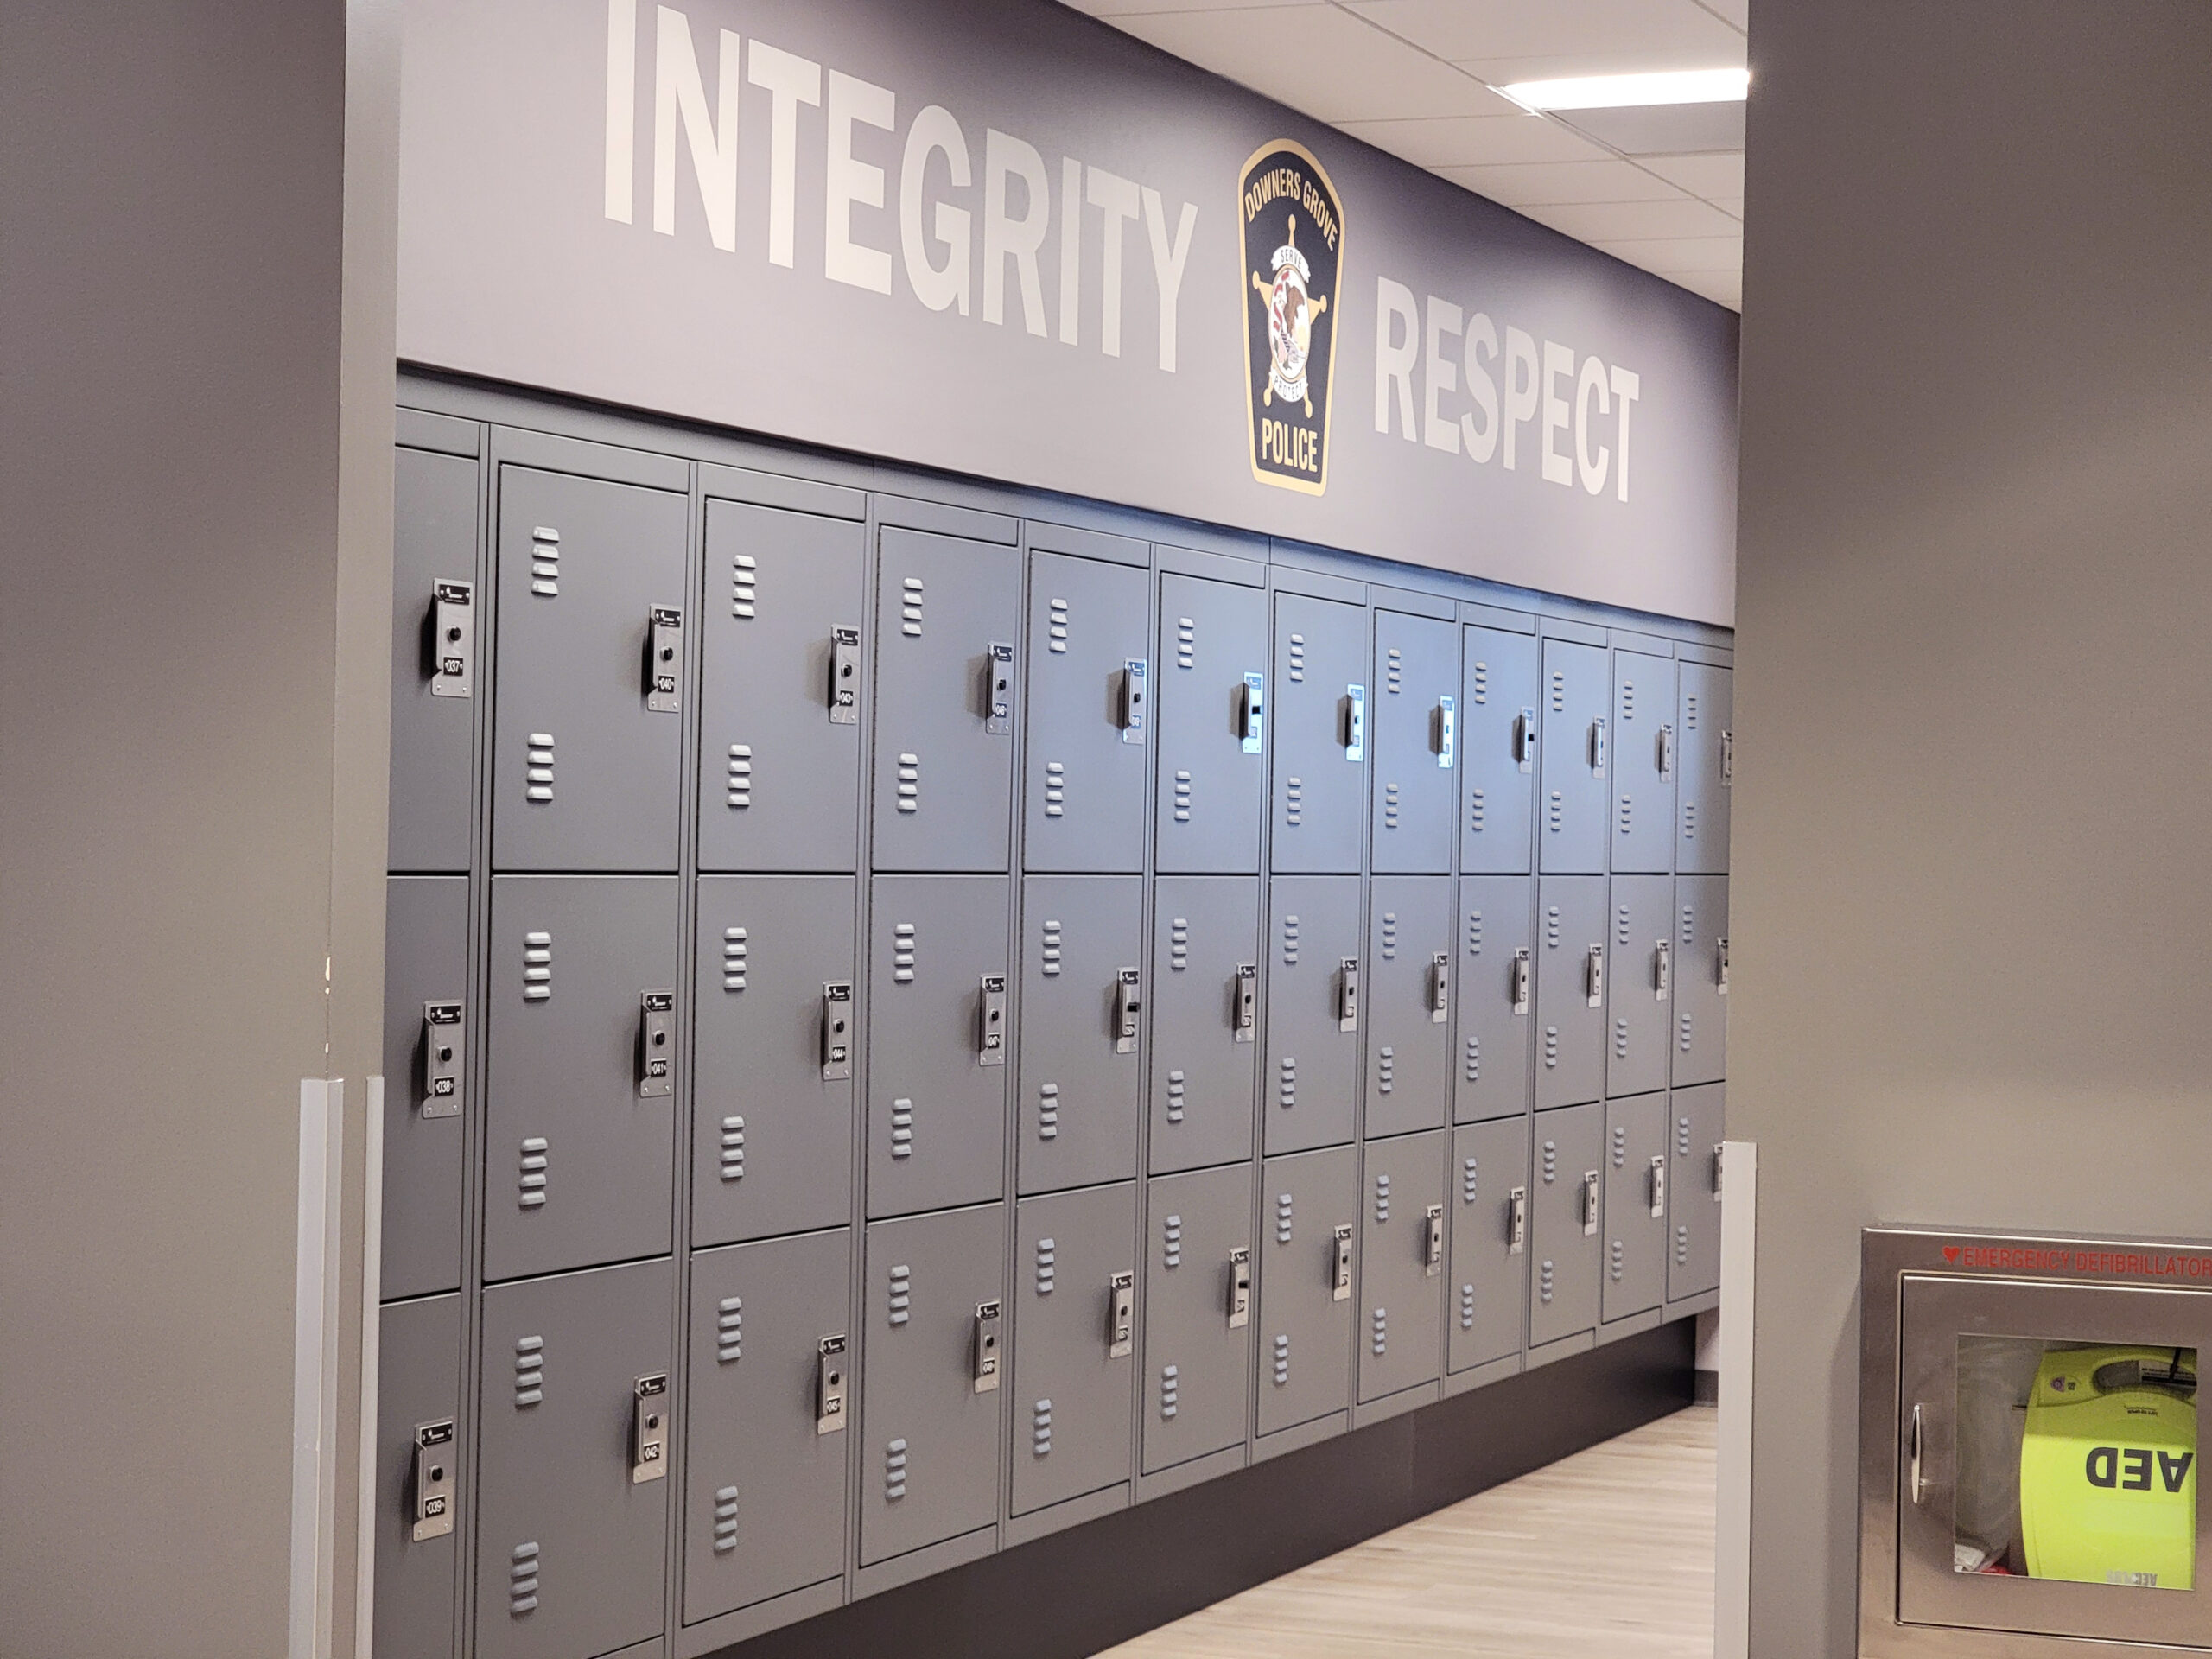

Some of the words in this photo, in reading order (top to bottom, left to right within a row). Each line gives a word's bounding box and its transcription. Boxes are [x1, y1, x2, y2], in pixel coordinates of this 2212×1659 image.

[604, 0, 1199, 373] INTEGRITY
[1245, 168, 1301, 222] DOWNERS
[1303, 181, 1338, 251] GROVE
[1281, 249, 1302, 269] SERVE
[1274, 375, 1302, 399] PROTECT
[1375, 276, 1640, 503] RESPECT
[1262, 418, 1318, 473] POLICE
[447, 659, 460, 672] 037
[437, 1080, 450, 1093] 038
[1962, 1247, 2069, 1270] EMERGENCY
[2076, 1252, 2212, 1277] DEFIBRILLATOR
[2086, 1446, 2194, 1493] AED
[429, 1500, 442, 1514] 039
